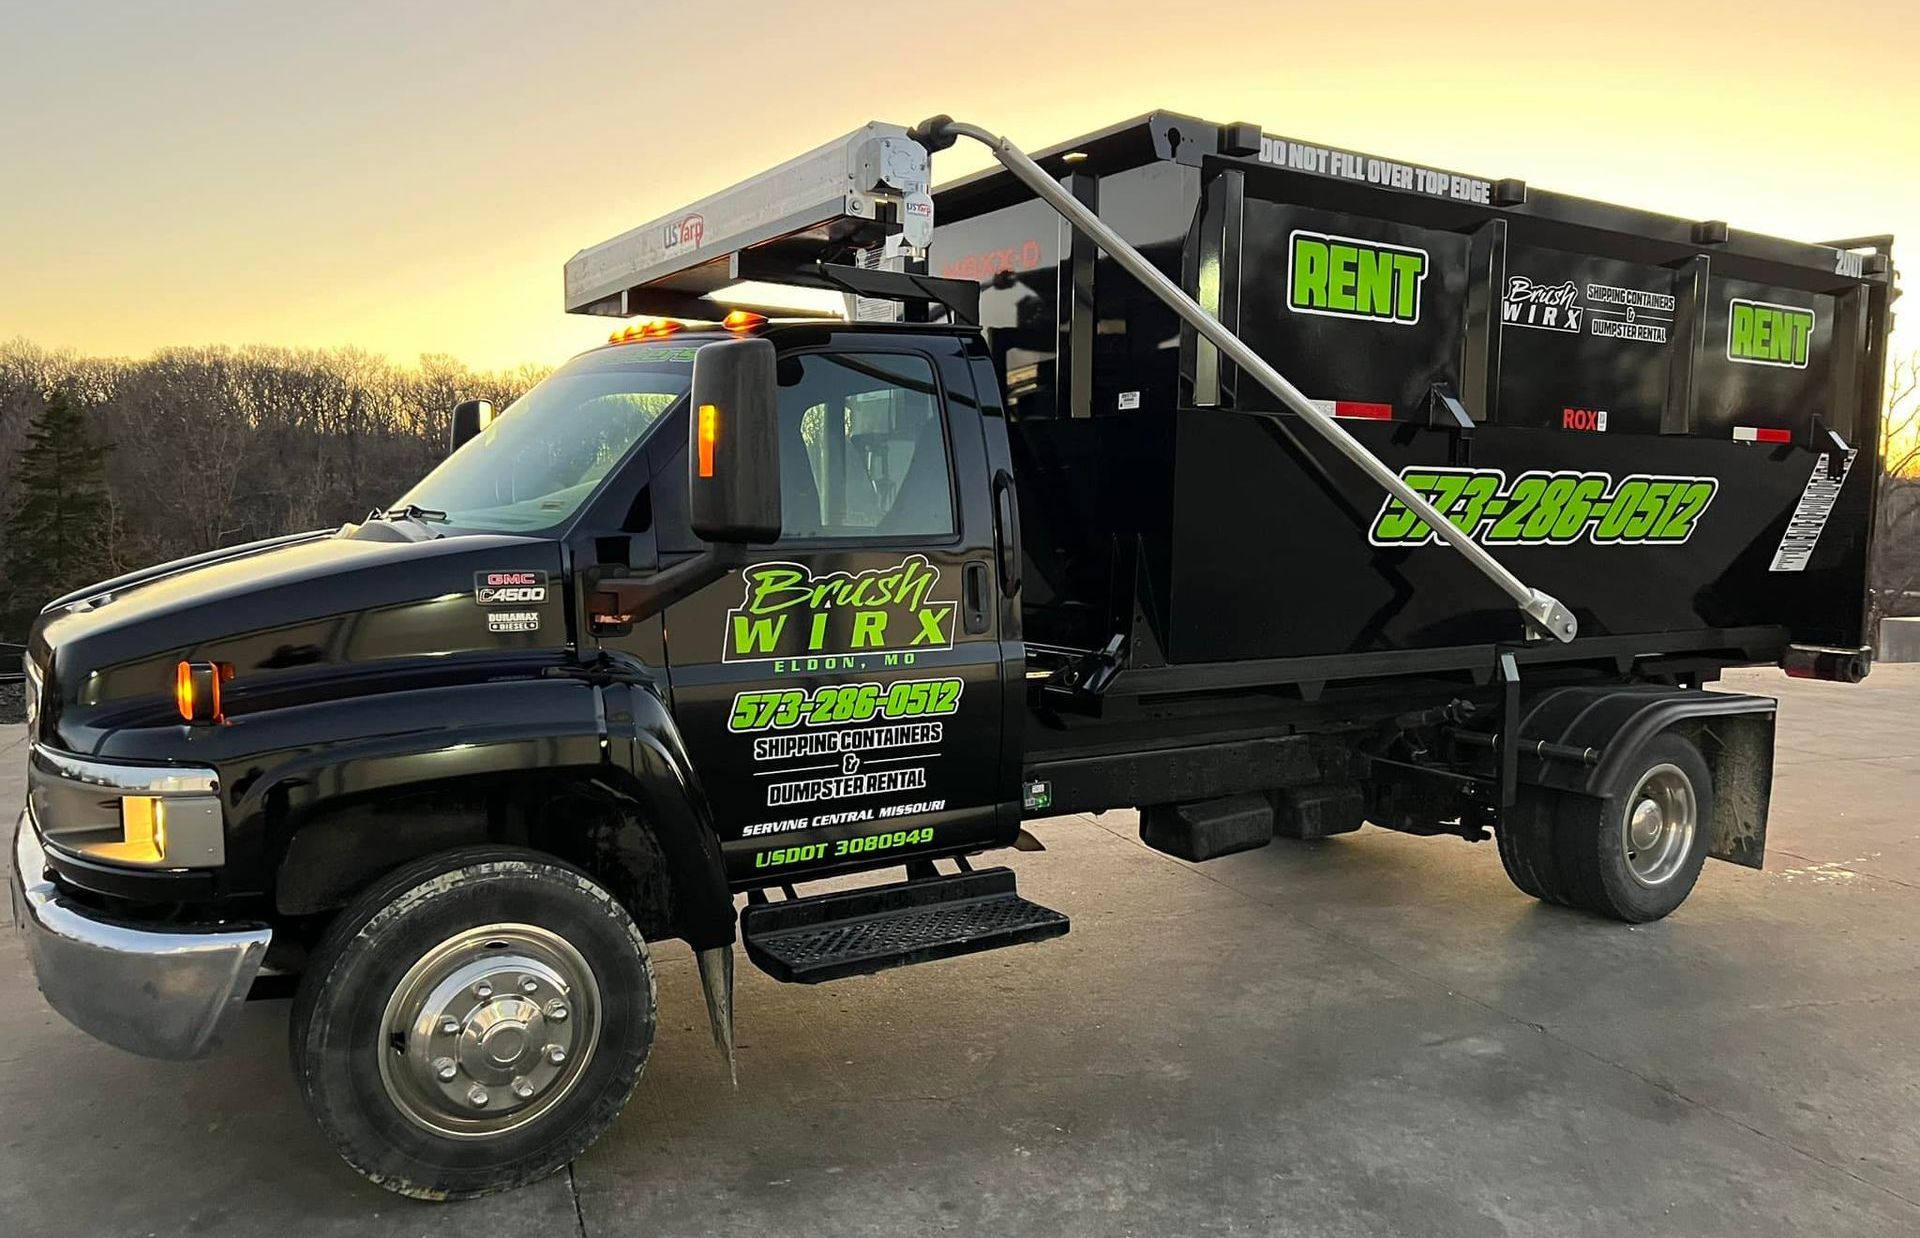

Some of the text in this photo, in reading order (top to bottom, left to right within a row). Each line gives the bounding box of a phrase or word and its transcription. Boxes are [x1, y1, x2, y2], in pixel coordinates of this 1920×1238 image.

[1258, 137, 1491, 205] DO NOT FILL OVER TOP EDGE
[1292, 238, 1423, 319] RENT
[1509, 279, 1577, 311] Brush
[1587, 284, 1675, 311] SHIPPING CONTAINERS
[1626, 307, 1635, 322] &
[1592, 319, 1667, 343] DUMPSTER RENTAL
[1730, 304, 1812, 364] RENT
[1563, 408, 1597, 430] ROX
[1374, 472, 1715, 541] 573-286-0512
[480, 587, 545, 602] C4500
[487, 573, 536, 585] GMC
[750, 561, 933, 614] Brush
[488, 612, 538, 622] DURAMAX
[500, 622, 527, 630] DIESEL
[733, 607, 951, 654] WIRX
[774, 653, 916, 674] ELDON, MO
[730, 680, 961, 730] 573-286-0512
[754, 722, 942, 760] SHIPPING CONTAINERS
[843, 753, 860, 774] &
[767, 768, 926, 806] DUMPSTER RENTAL
[742, 799, 946, 837] SERVING CENTRAL MISSOURI
[755, 827, 934, 868] USDOT 3080949
